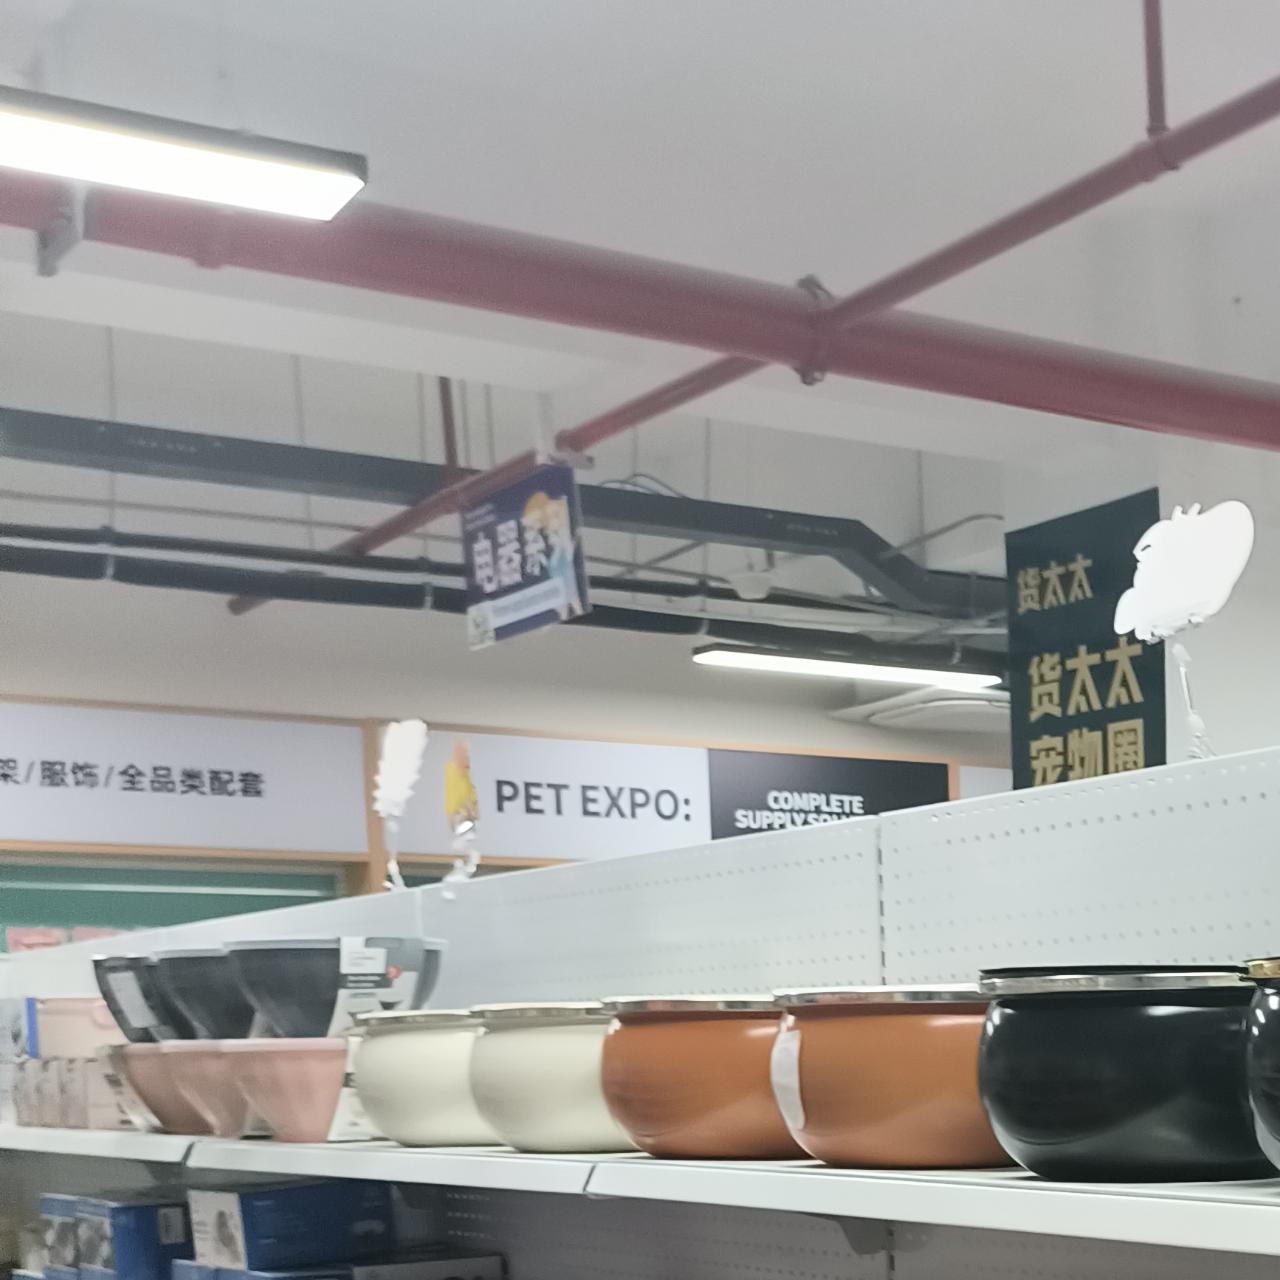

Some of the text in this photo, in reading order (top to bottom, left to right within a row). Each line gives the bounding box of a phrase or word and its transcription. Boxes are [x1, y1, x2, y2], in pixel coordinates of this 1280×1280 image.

[1017, 553, 1093, 615] 货太太
[1029, 636, 1144, 722] 货太太
[496, 779, 691, 822] PET EXPO:
[735, 808, 805, 830] SUPPLY
[767, 789, 864, 815] COMPLETE
